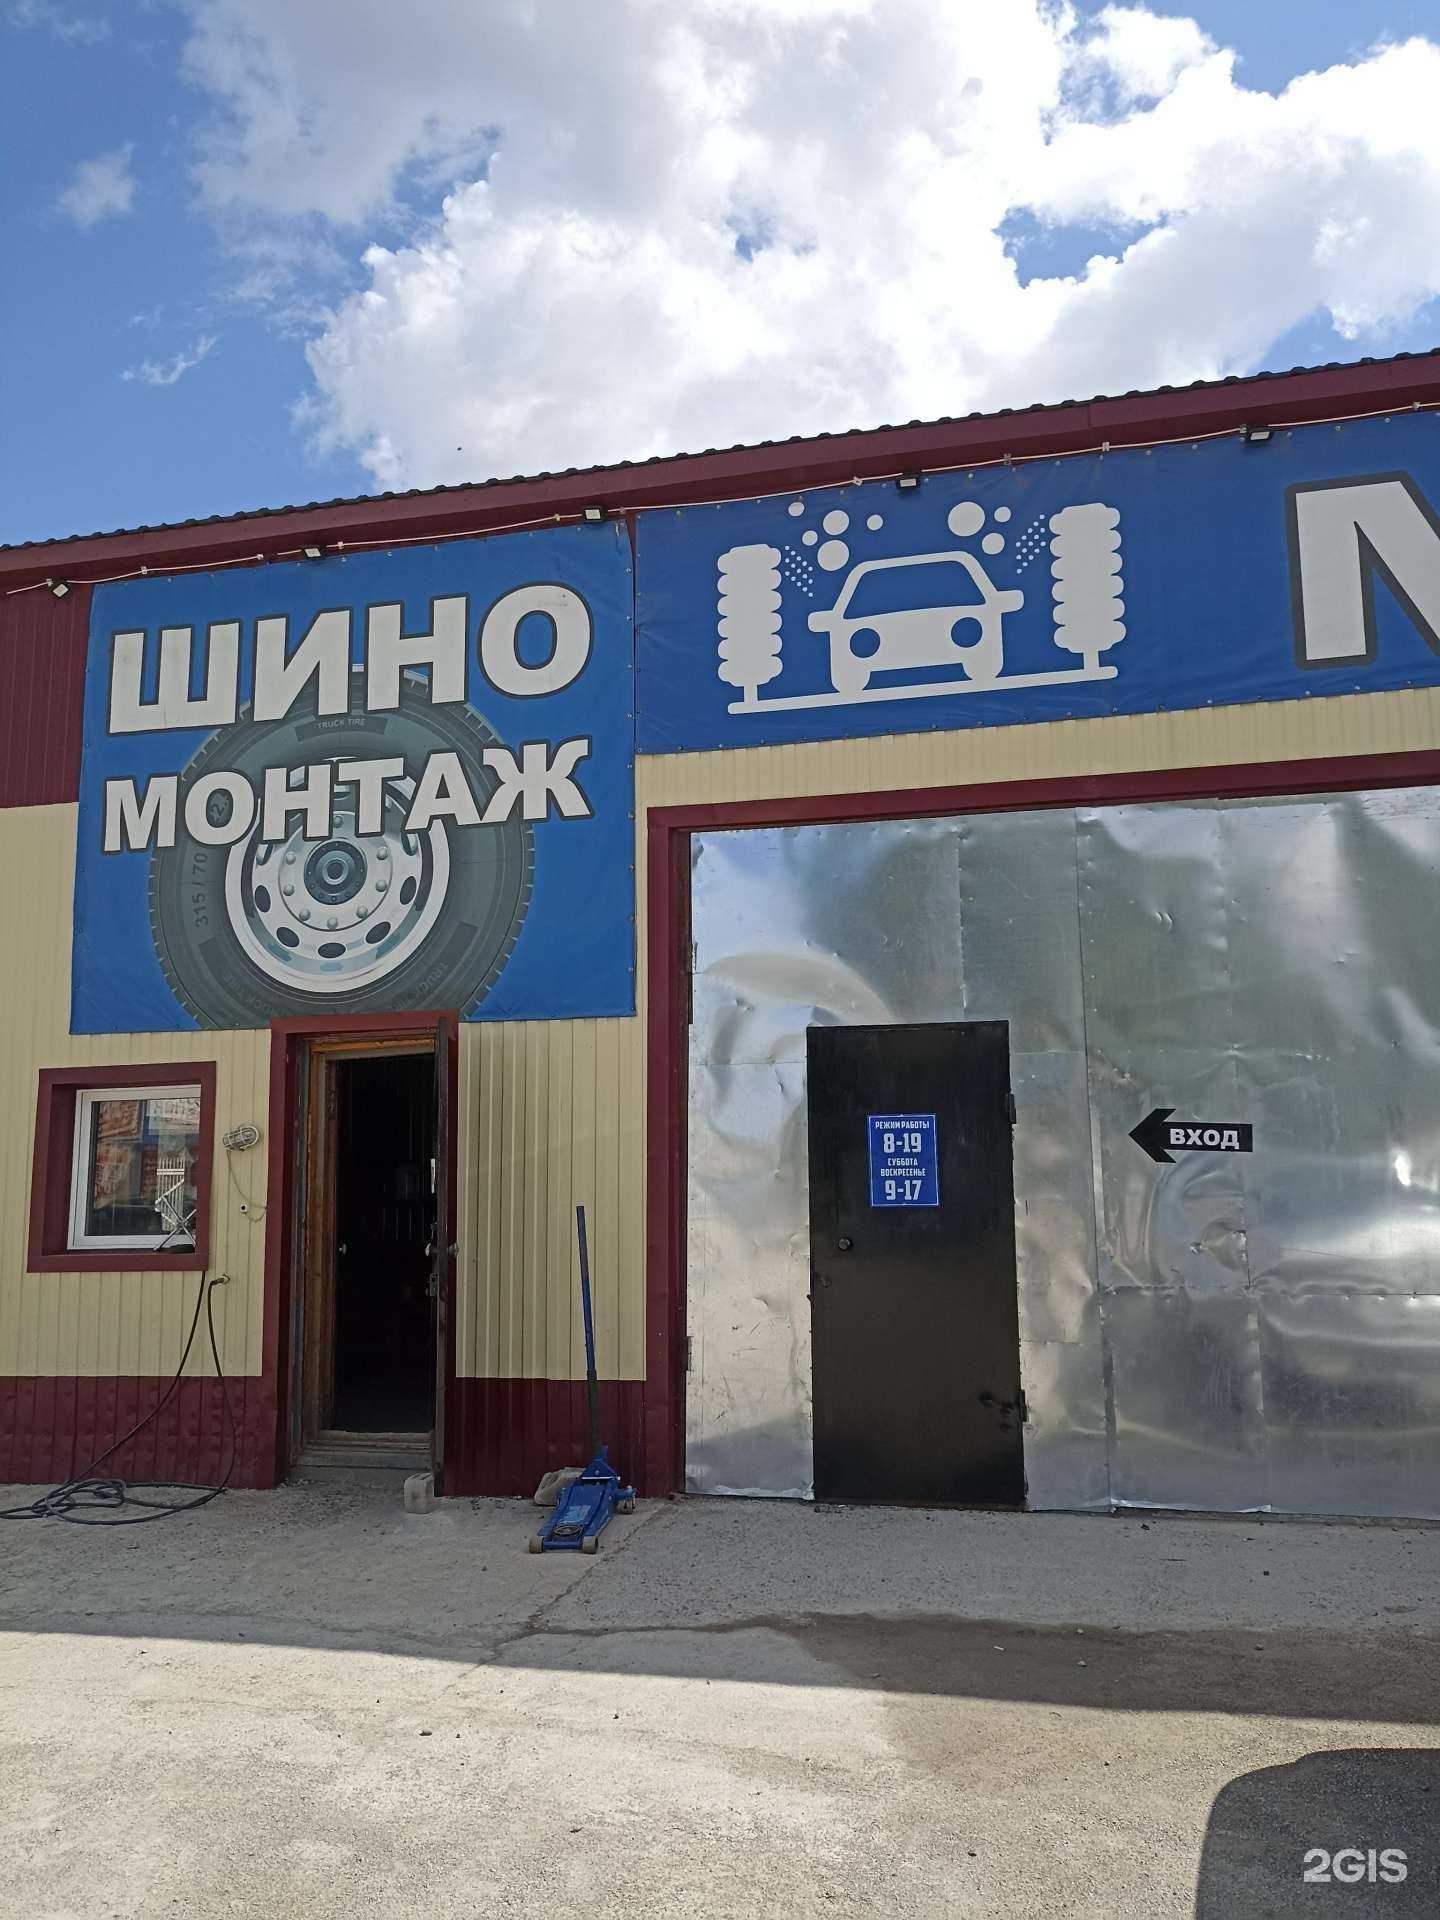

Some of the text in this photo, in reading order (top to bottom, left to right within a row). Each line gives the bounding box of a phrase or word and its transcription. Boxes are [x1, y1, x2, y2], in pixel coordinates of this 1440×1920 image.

[108, 584, 592, 734] ШИНО
[317, 718, 366, 729] TRUCK TIRE
[103, 738, 592, 853] МОНТАЖ
[875, 1120, 930, 1129] РЕЖИМ РАБОТЫ
[883, 1132, 922, 1154] 8-19
[1169, 1128, 1240, 1150] ВХОД
[880, 1168, 926, 1177] ВОСКРЕСЕНЬЕ
[887, 1157, 918, 1167] СУББОТА
[884, 1179, 922, 1201] 9-17
